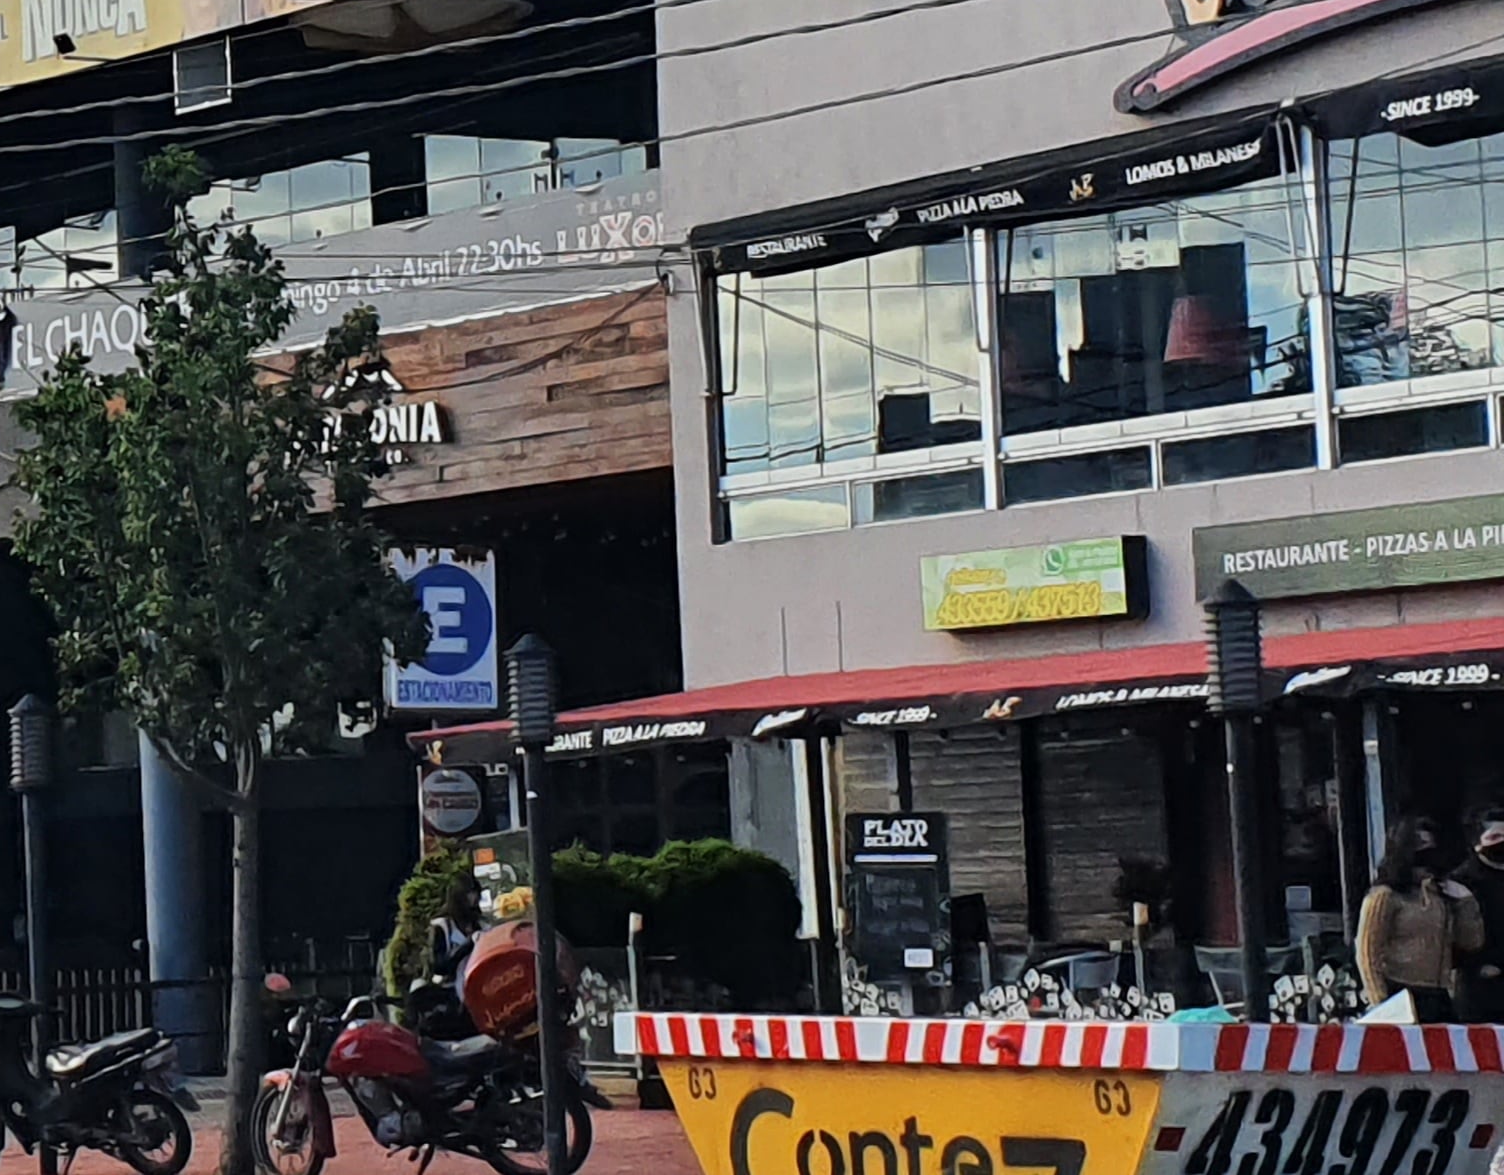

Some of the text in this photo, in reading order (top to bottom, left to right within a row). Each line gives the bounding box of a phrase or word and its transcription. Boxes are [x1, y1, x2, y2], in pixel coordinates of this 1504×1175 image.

[1125, 159, 1174, 185] LOMOS
[1223, 538, 1350, 574] RESTAURANTE
[1365, 531, 1430, 558] PIZZAS
[1434, 531, 1448, 552] A
[1453, 526, 1477, 549] LA
[422, 586, 469, 654] E
[1444, 663, 1489, 685] 1999
[397, 679, 493, 704] ESTACIONAMIENTO
[863, 819, 929, 836] PLATO
[890, 831, 929, 848] DIA
